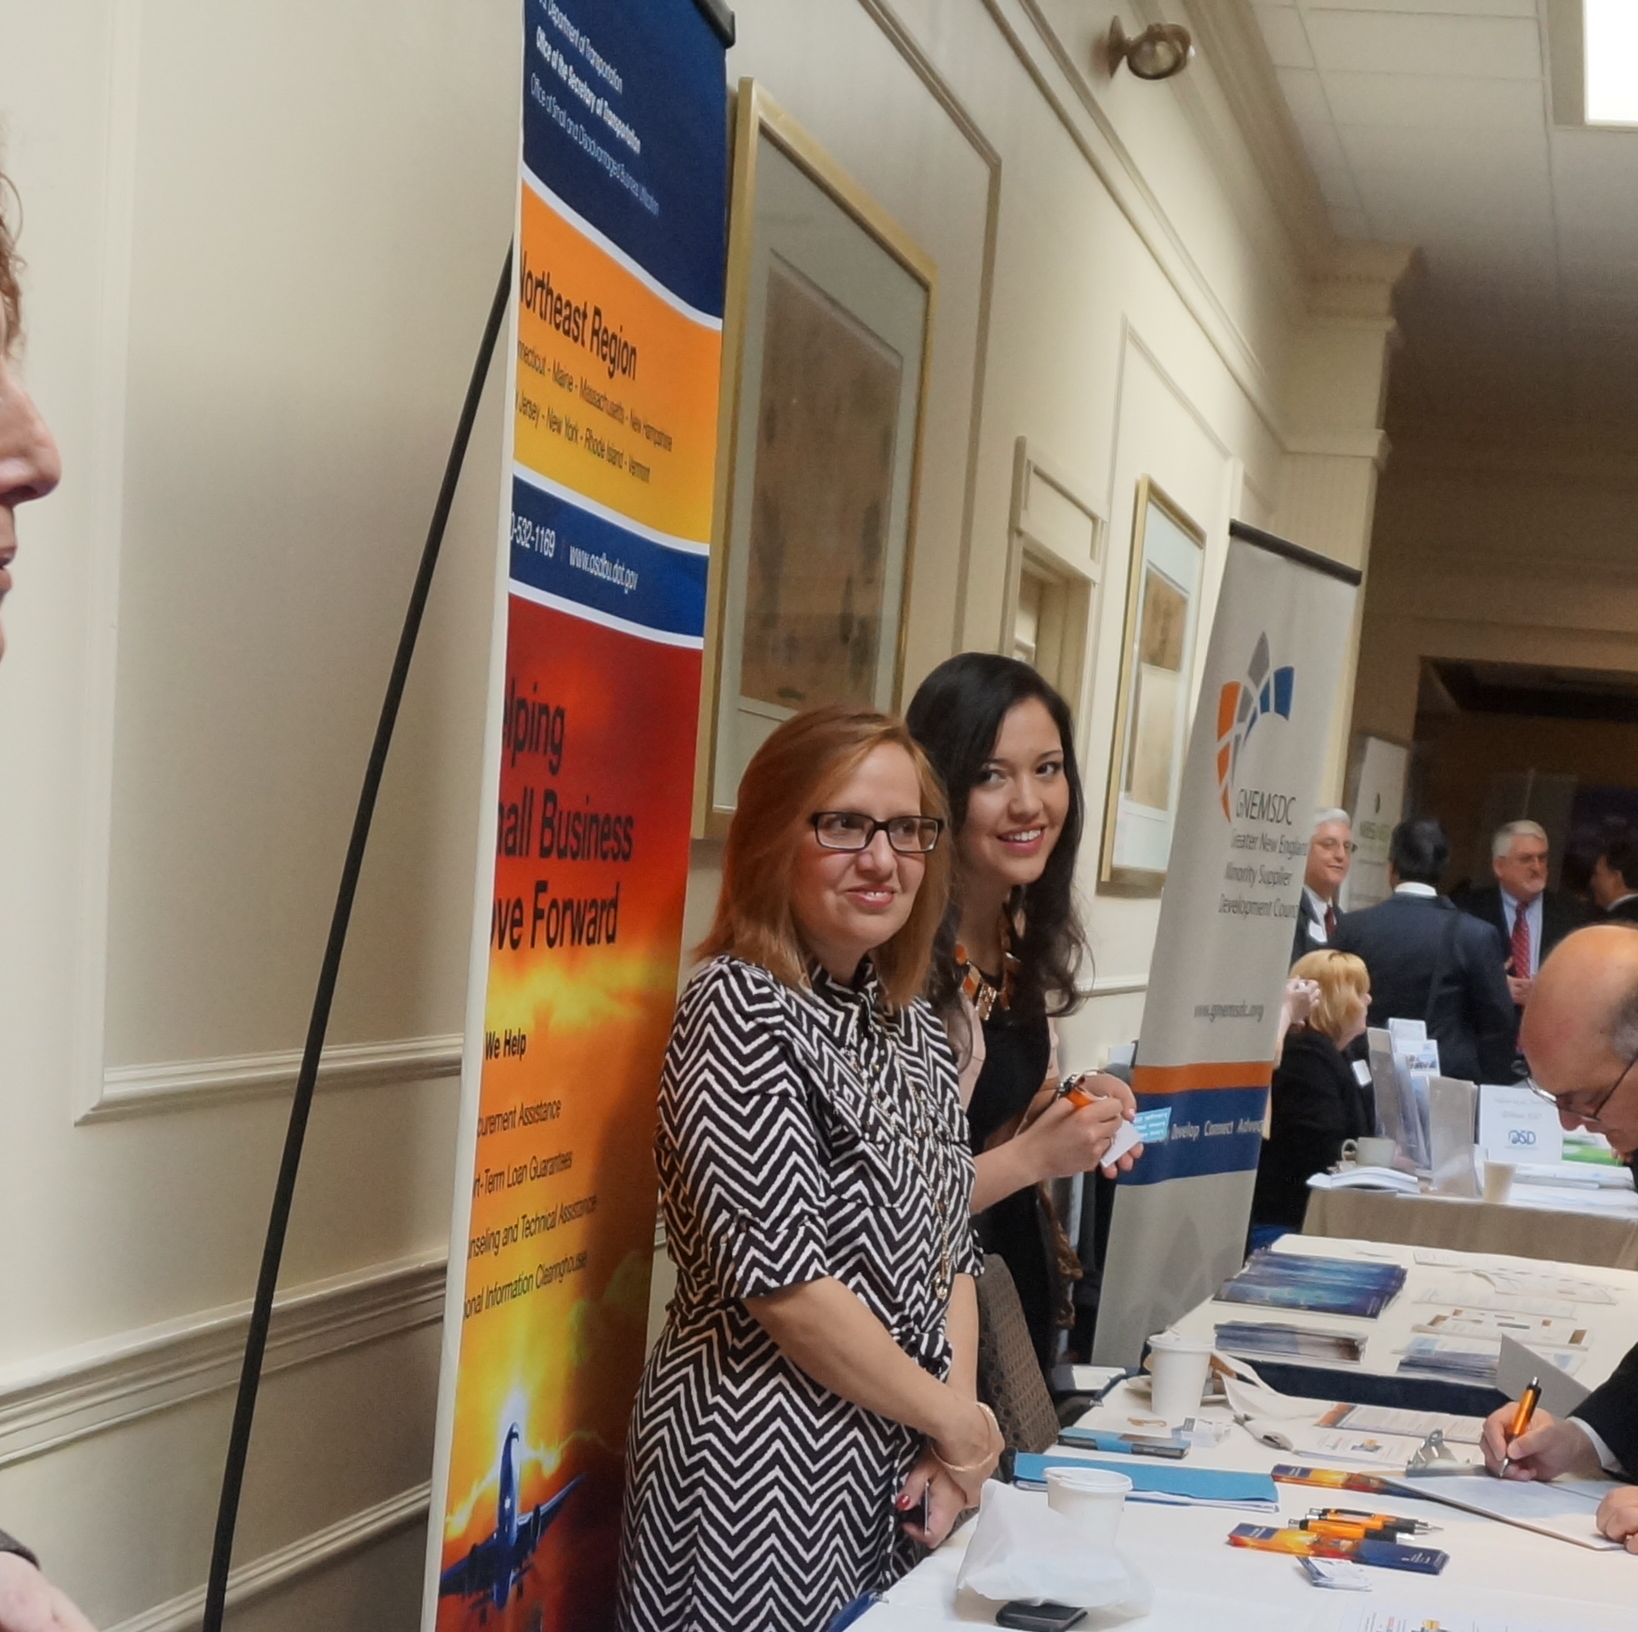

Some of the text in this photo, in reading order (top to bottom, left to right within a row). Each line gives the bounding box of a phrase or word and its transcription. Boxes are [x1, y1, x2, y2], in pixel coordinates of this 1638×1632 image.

[589, 304, 638, 382] Region
[551, 359, 575, 395] Maine
[545, 406, 563, 437] New
[563, 415, 579, 446] York
[585, 426, 606, 460] Rhode
[504, 677, 566, 777] lping
[497, 786, 635, 863] all Business
[1235, 787, 1297, 826] GNEMSDC
[529, 879, 622, 950] Forward
[502, 1027, 528, 1063] Help
[518, 1099, 562, 1128] Assistance
[473, 1166, 505, 1199] rt-Term
[506, 1162, 528, 1190] Loan
[468, 1225, 501, 1259] nseling
[501, 1217, 520, 1247] and
[521, 1203, 558, 1240] Technical
[484, 1270, 535, 1310] Information
